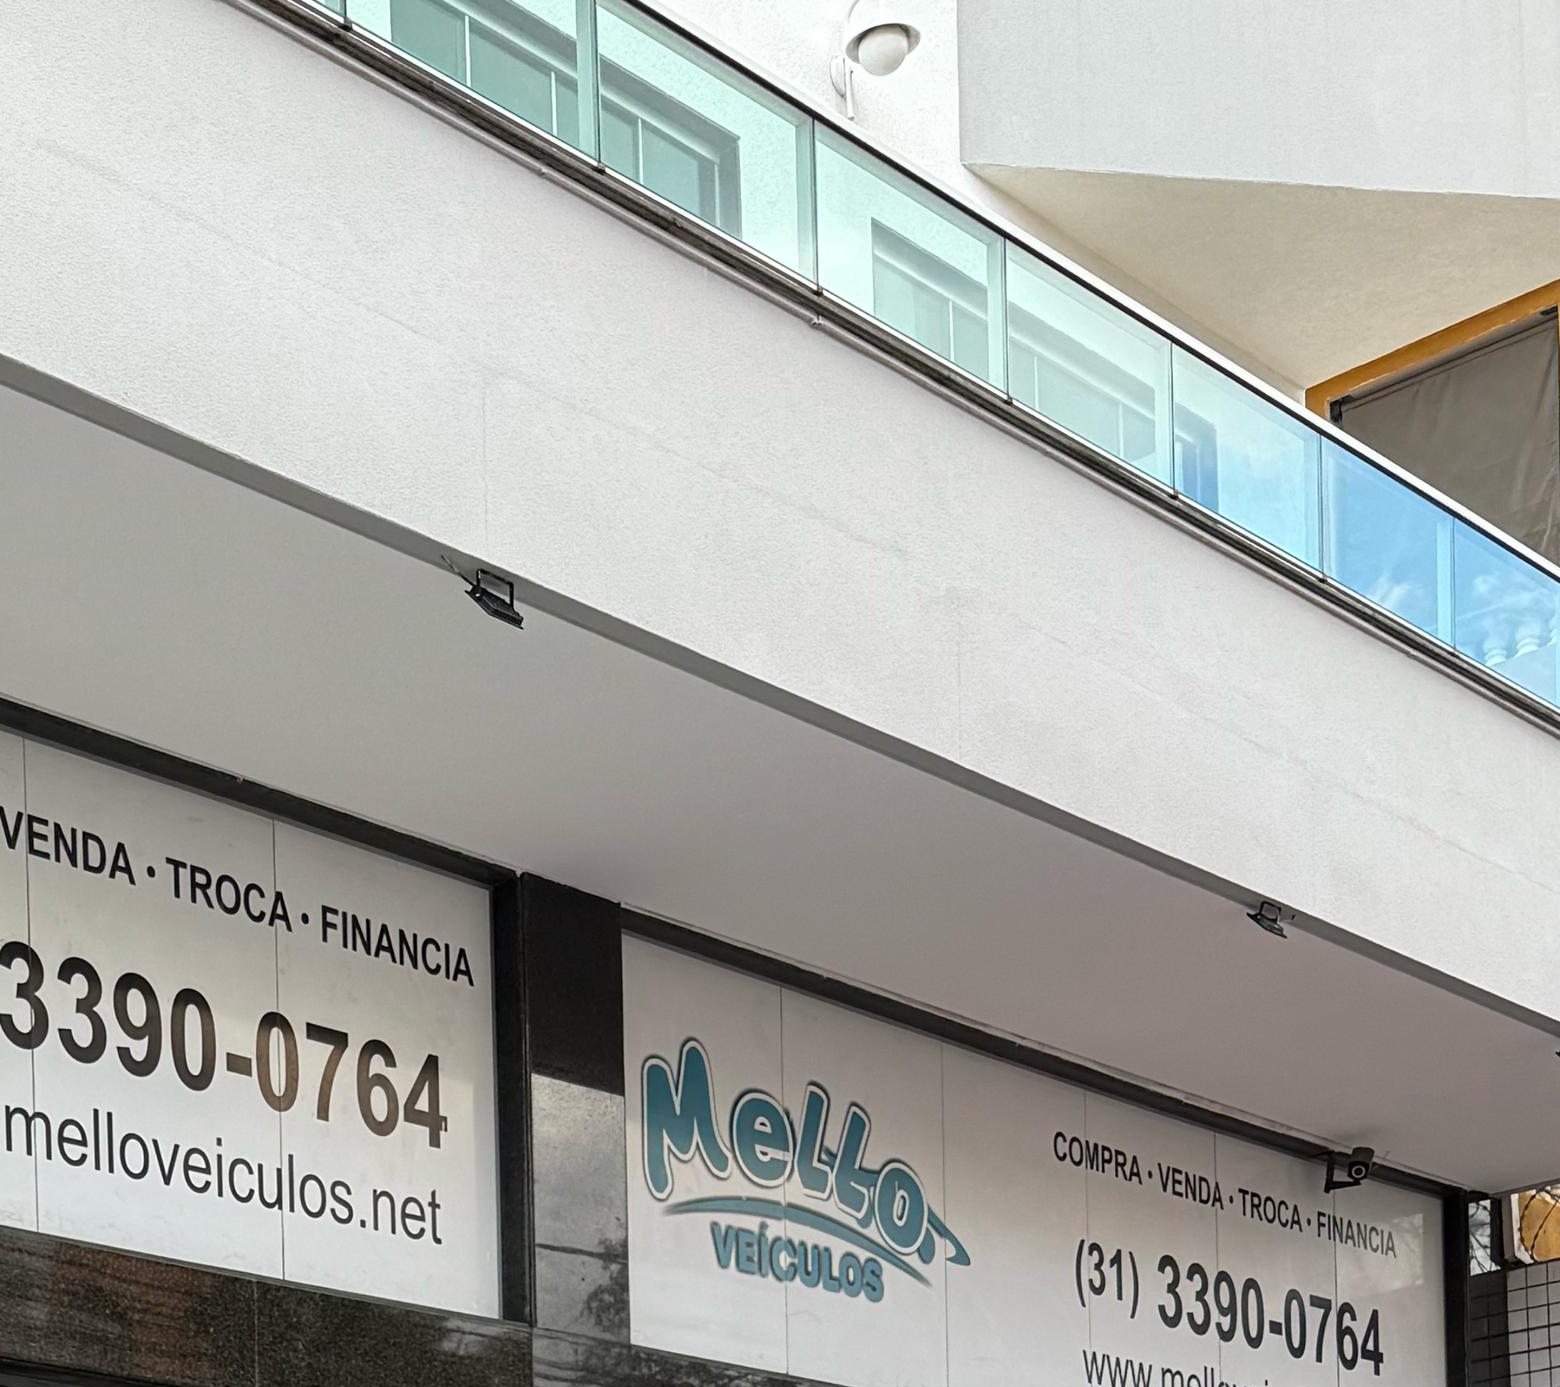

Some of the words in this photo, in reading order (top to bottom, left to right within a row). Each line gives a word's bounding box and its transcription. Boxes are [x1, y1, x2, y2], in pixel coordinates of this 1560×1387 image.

[165, 856, 293, 933] TROCA
[321, 904, 475, 988] FINANCIA
[1053, 1131, 1143, 1186] COMPRA
[1157, 1162, 1224, 1211] VENDA
[1238, 1187, 1303, 1233] TROCA
[1317, 1210, 1397, 1259] FINANCIA
[710, 1221, 885, 1303] VEÍCULOS
[1075, 1239, 1139, 1320] (31)
[1157, 1254, 1384, 1377] 3390-0764
